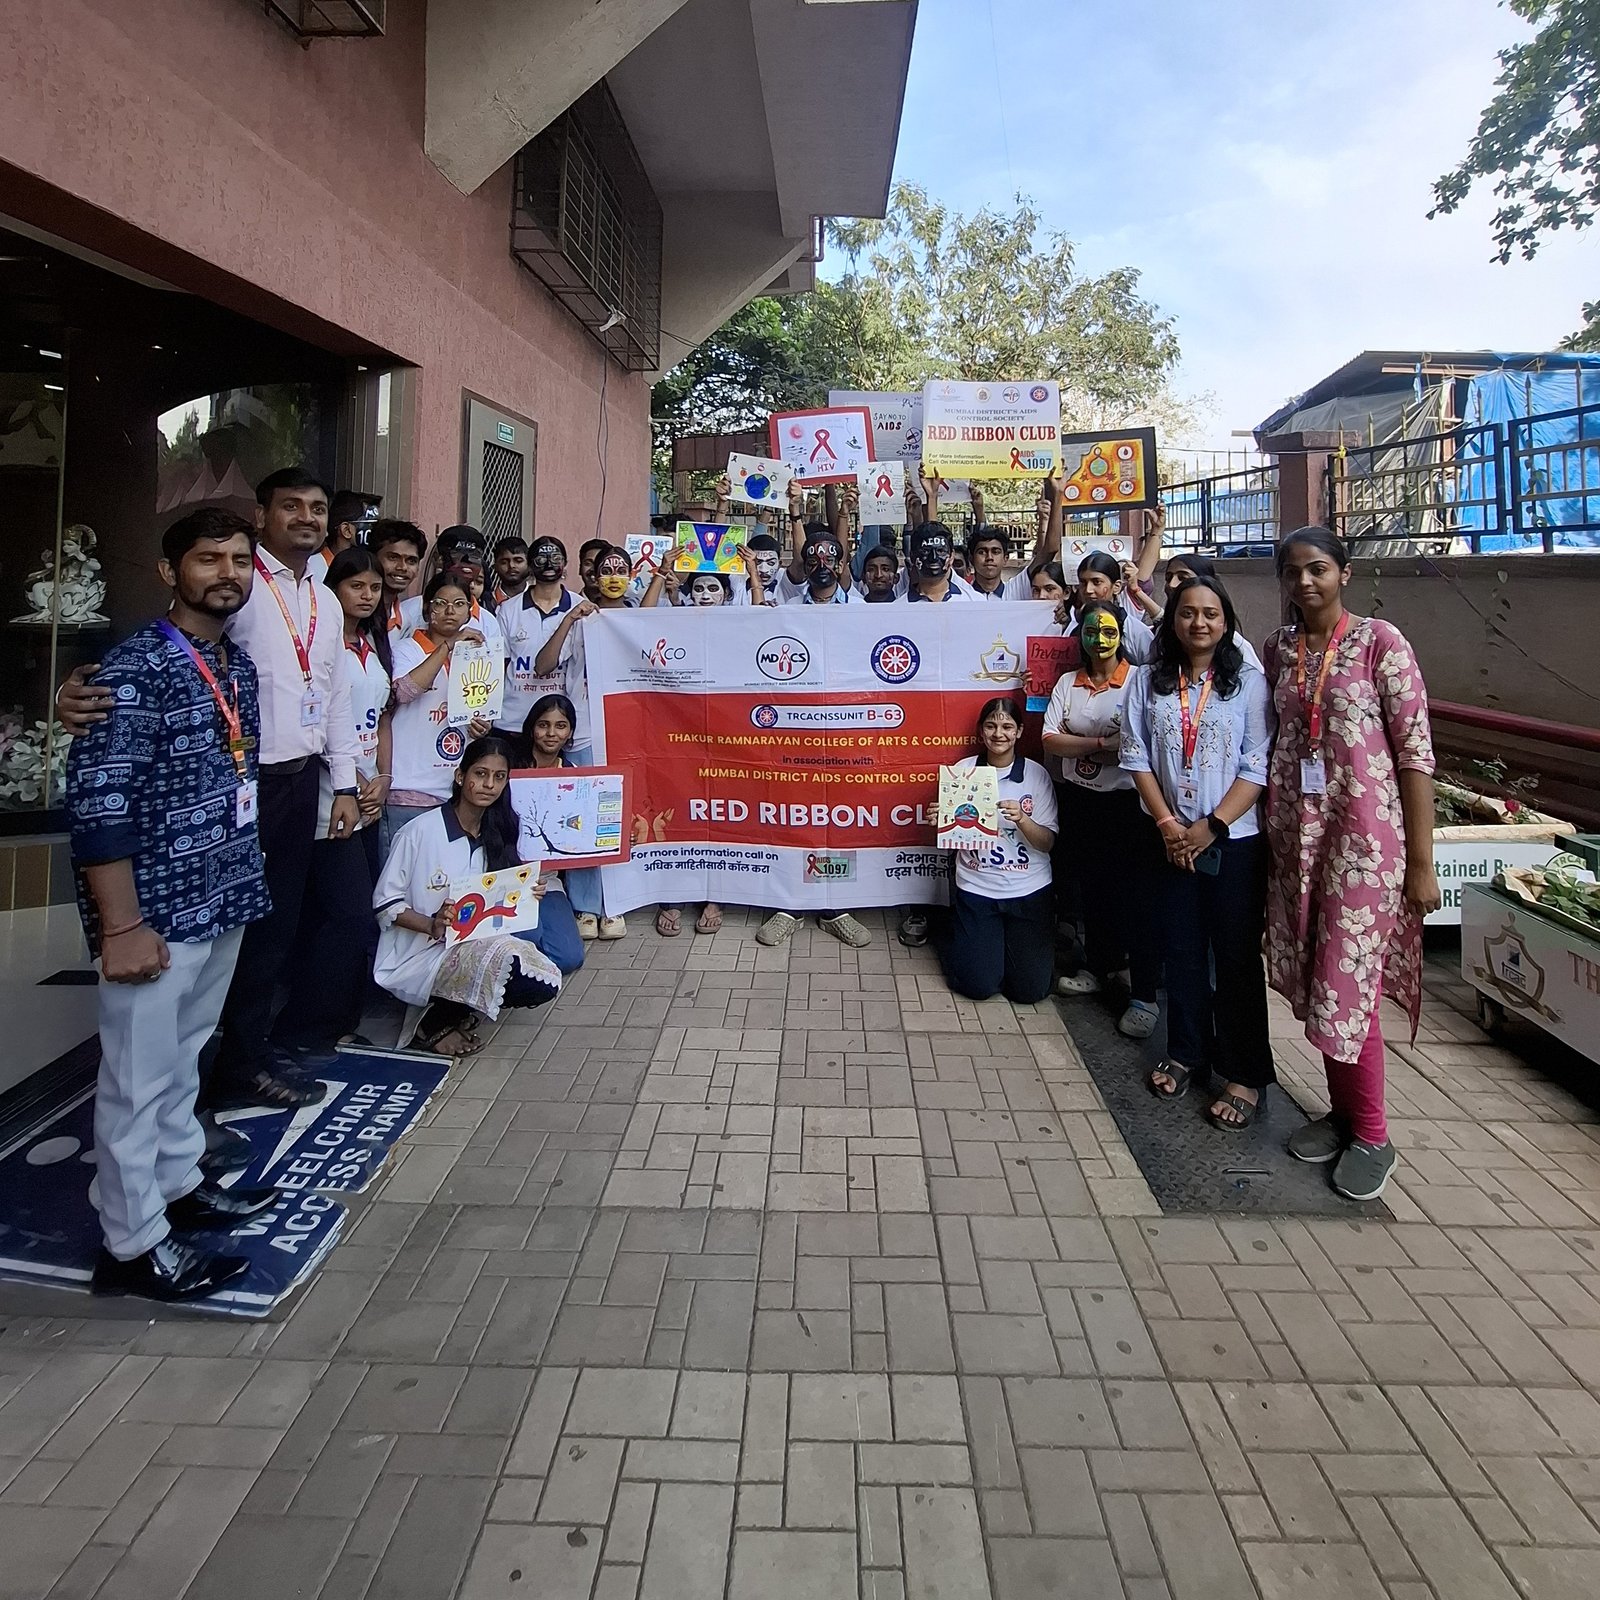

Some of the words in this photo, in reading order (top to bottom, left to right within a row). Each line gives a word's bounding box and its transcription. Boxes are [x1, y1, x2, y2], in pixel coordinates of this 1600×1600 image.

[873, 412, 888, 421] SAY
[877, 421, 902, 431] AIDS
[927, 425, 957, 440] RED
[961, 426, 1015, 441] RIBBON
[1019, 425, 1056, 440] CLUB
[817, 463, 835, 472] HIV
[1027, 458, 1052, 469] 1097
[921, 537, 946, 547] AIDS
[538, 545, 557, 553] AIDS
[760, 650, 806, 668] MDACS
[462, 684, 492, 697] STOP
[787, 711, 865, 721] TRCACNSSUNIT
[867, 709, 902, 721] B-63
[668, 733, 714, 744] THAKUR
[717, 735, 801, 746] RAMNARAYAN
[803, 736, 855, 747] COLLEGE
[858, 736, 874, 746] OF
[877, 736, 908, 746] ARTS
[911, 736, 920, 746] &
[793, 755, 851, 765] association
[851, 756, 874, 766] with
[698, 768, 749, 779] MUMBAI
[753, 770, 809, 782] DISTRICT
[812, 773, 841, 783] AIDS
[845, 773, 905, 784] CONTROL
[689, 798, 749, 822] RED
[758, 801, 880, 828] RIBBON
[630, 851, 649, 861] For
[649, 849, 679, 858] more
[680, 847, 744, 858] information
[744, 850, 763, 860] call
[765, 852, 779, 861] on
[895, 851, 938, 864] भेदभाव
[644, 860, 673, 873] अधिक
[674, 859, 726, 872] माहितीसाठी
[727, 860, 750, 872] कॉल
[751, 864, 770, 874] करा
[823, 863, 848, 875] 1097
[357, 1082, 419, 1141] RAMP
